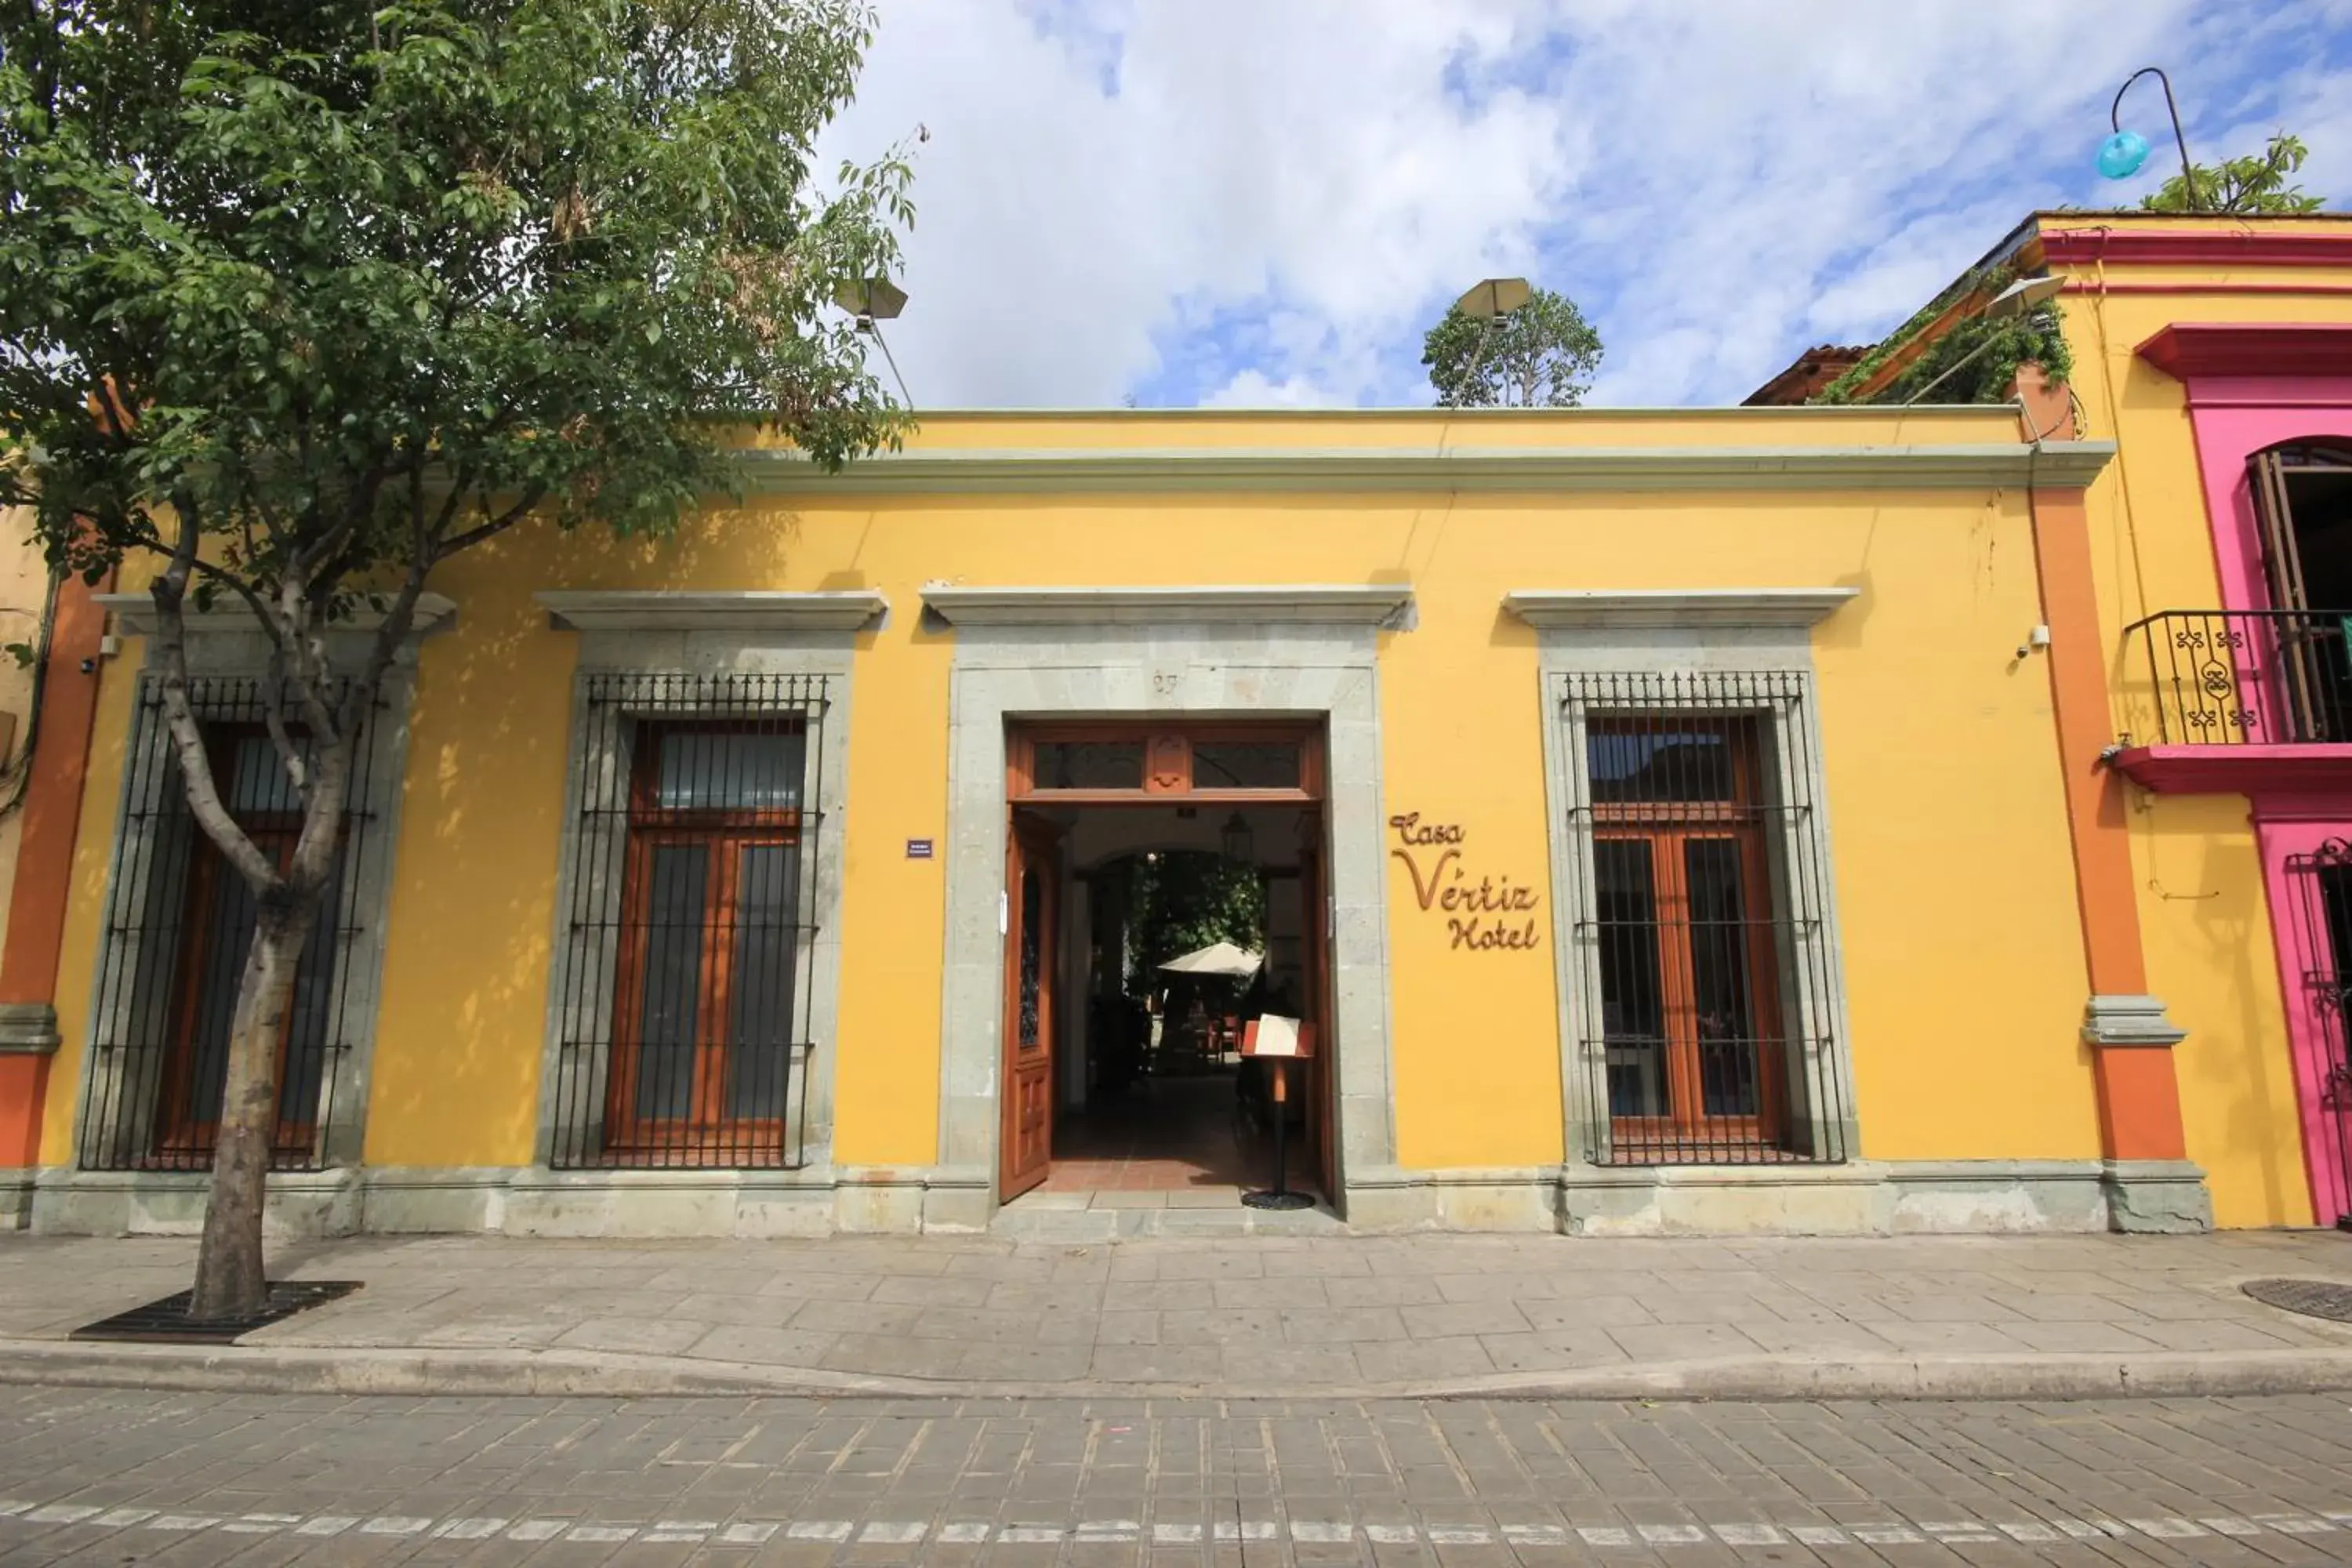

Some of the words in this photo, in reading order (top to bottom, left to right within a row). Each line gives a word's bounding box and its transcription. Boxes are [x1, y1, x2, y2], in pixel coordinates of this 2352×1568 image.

[1389, 811, 1466, 845] Casa
[1391, 848, 1540, 911] Vértiz
[1447, 917, 1541, 950] Hotel
